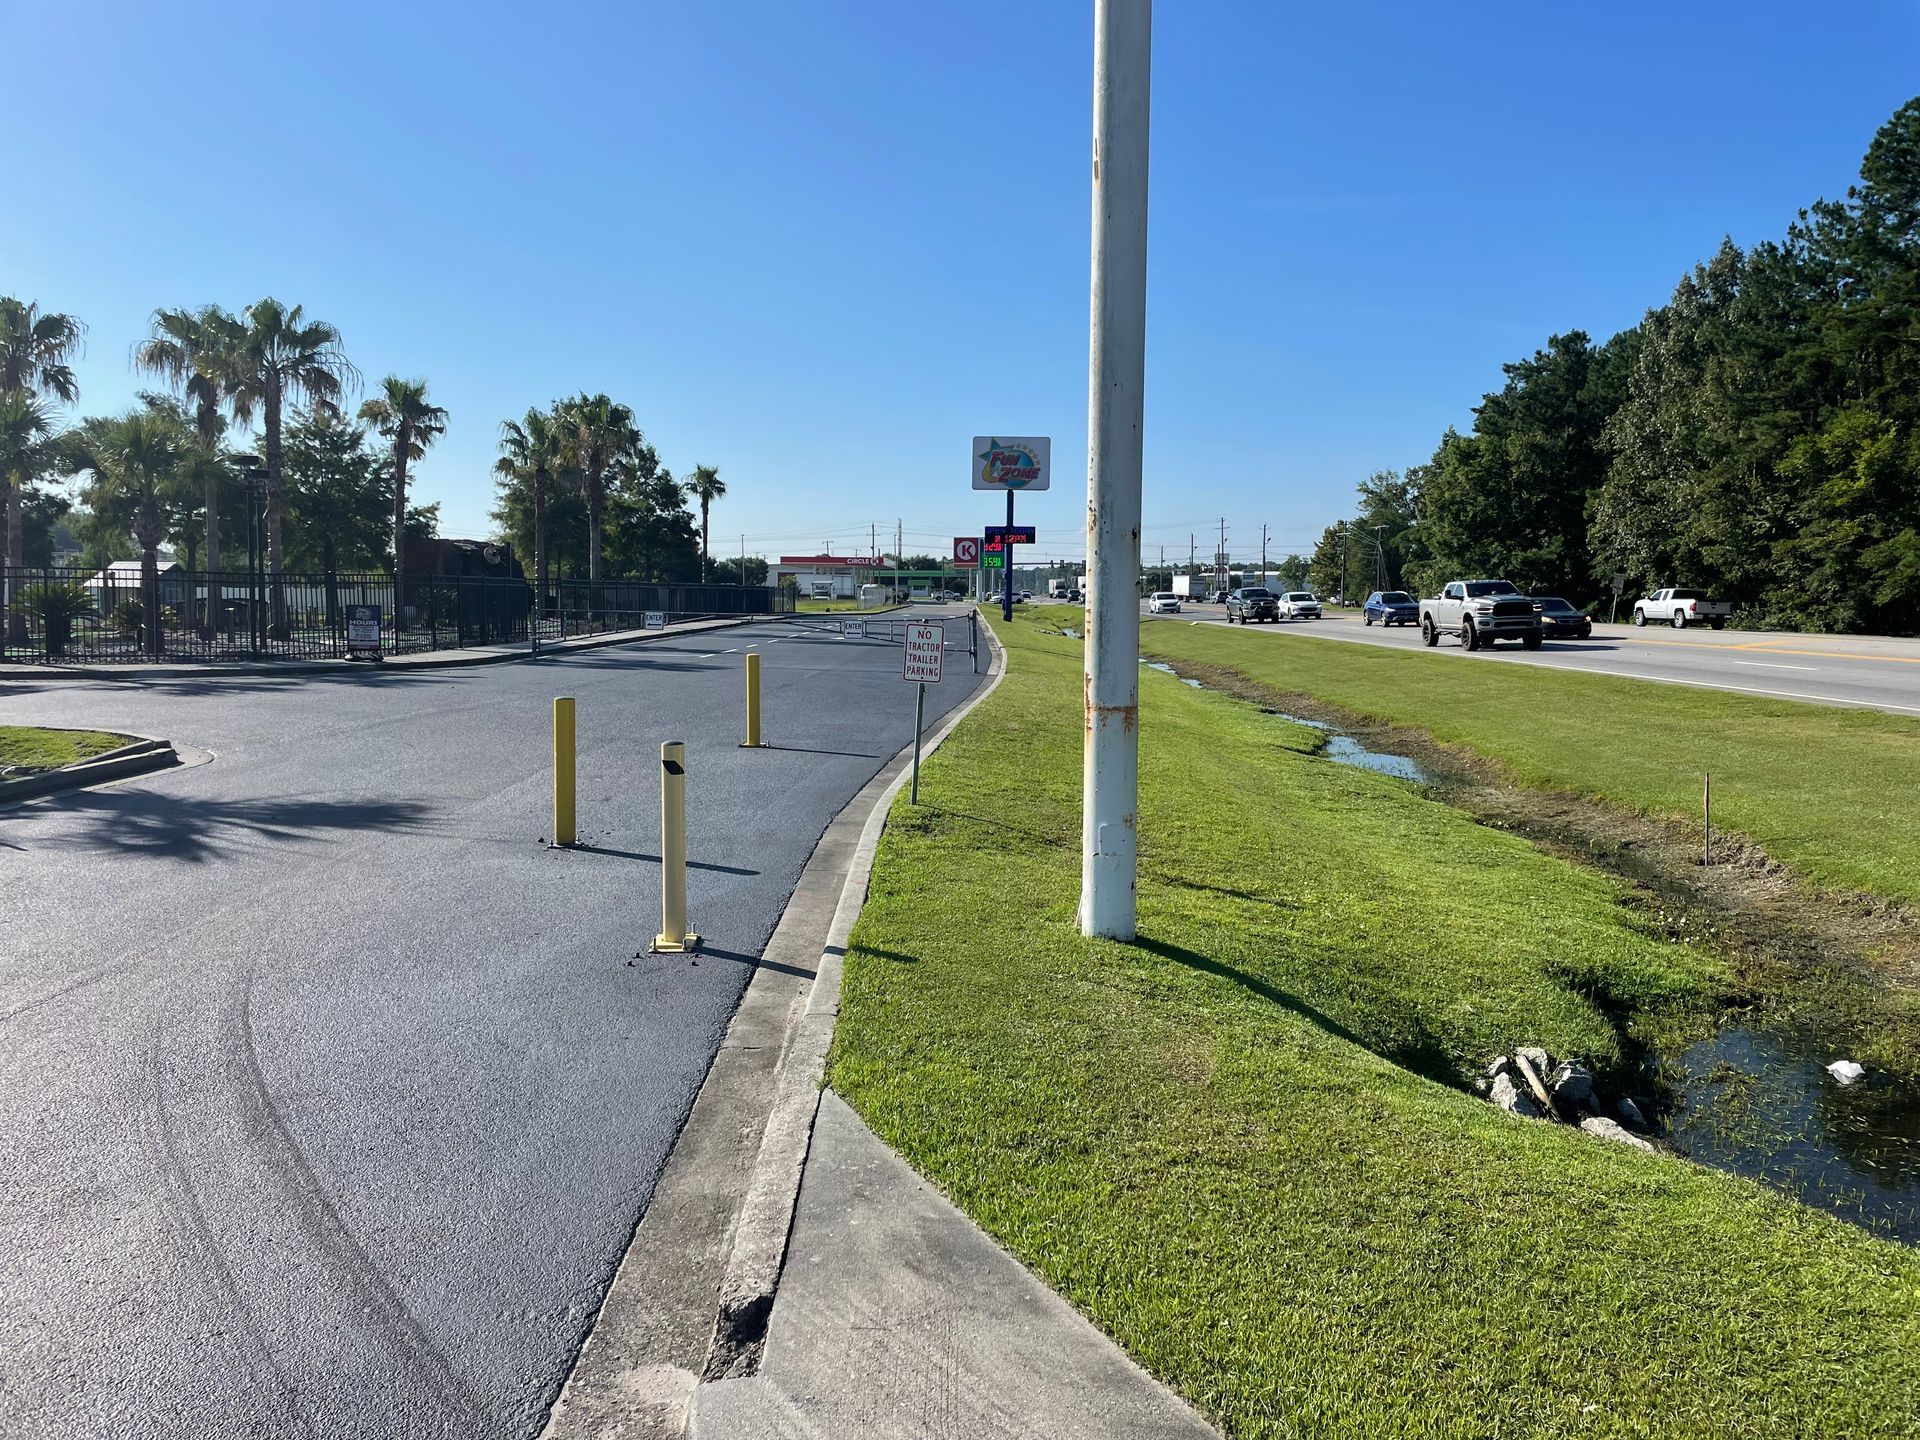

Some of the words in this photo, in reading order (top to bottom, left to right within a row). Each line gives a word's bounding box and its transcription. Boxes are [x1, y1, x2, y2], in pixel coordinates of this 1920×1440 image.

[960, 543, 974, 560] K
[871, 557, 879, 566] K
[917, 630, 932, 640] NO
[909, 641, 940, 653] TRACTOR
[909, 653, 938, 665] TRAILER
[906, 665, 939, 677] PARKING
